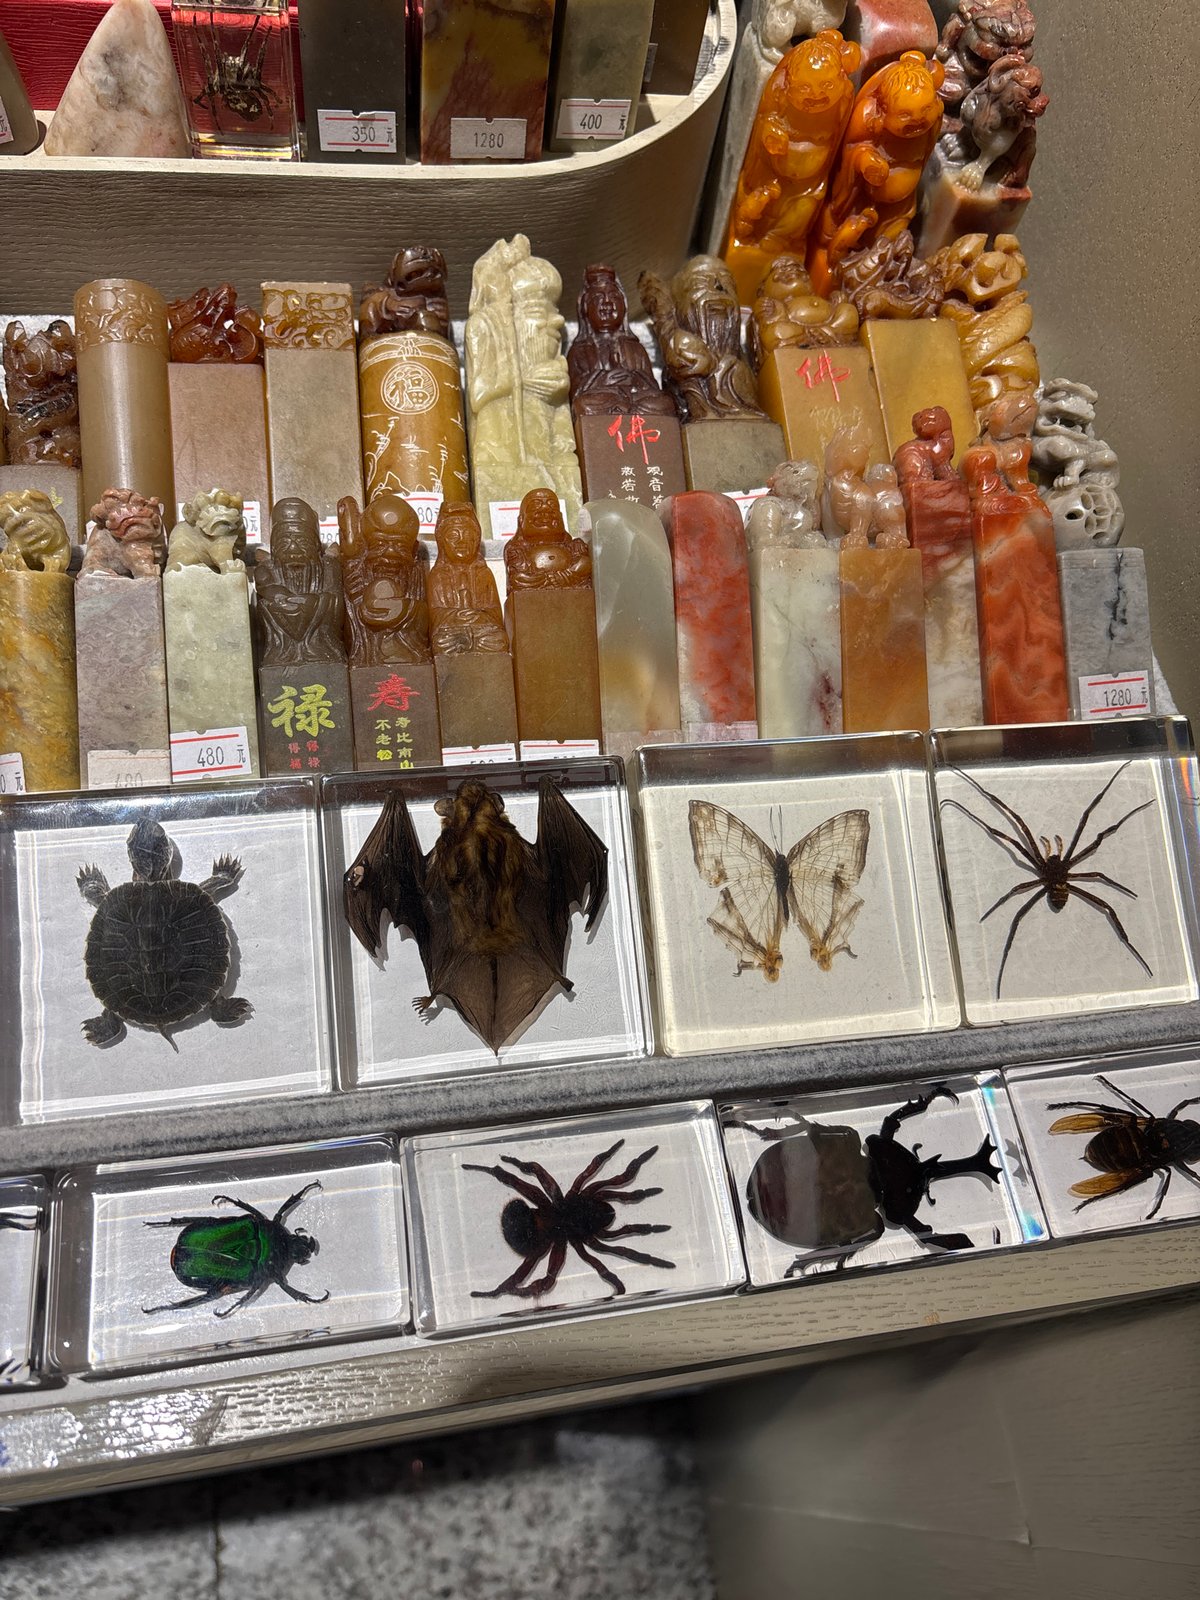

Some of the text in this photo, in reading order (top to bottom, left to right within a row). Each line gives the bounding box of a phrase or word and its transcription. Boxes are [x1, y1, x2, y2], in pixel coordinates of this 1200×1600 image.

[580, 113, 602, 130] 400
[352, 126, 376, 142] 350
[473, 132, 504, 148] 1280
[607, 415, 661, 465] 佛
[367, 673, 420, 711] 寿
[1104, 688, 1131, 707] 1280
[267, 684, 336, 737] 禄
[197, 744, 246, 767] 480 元
